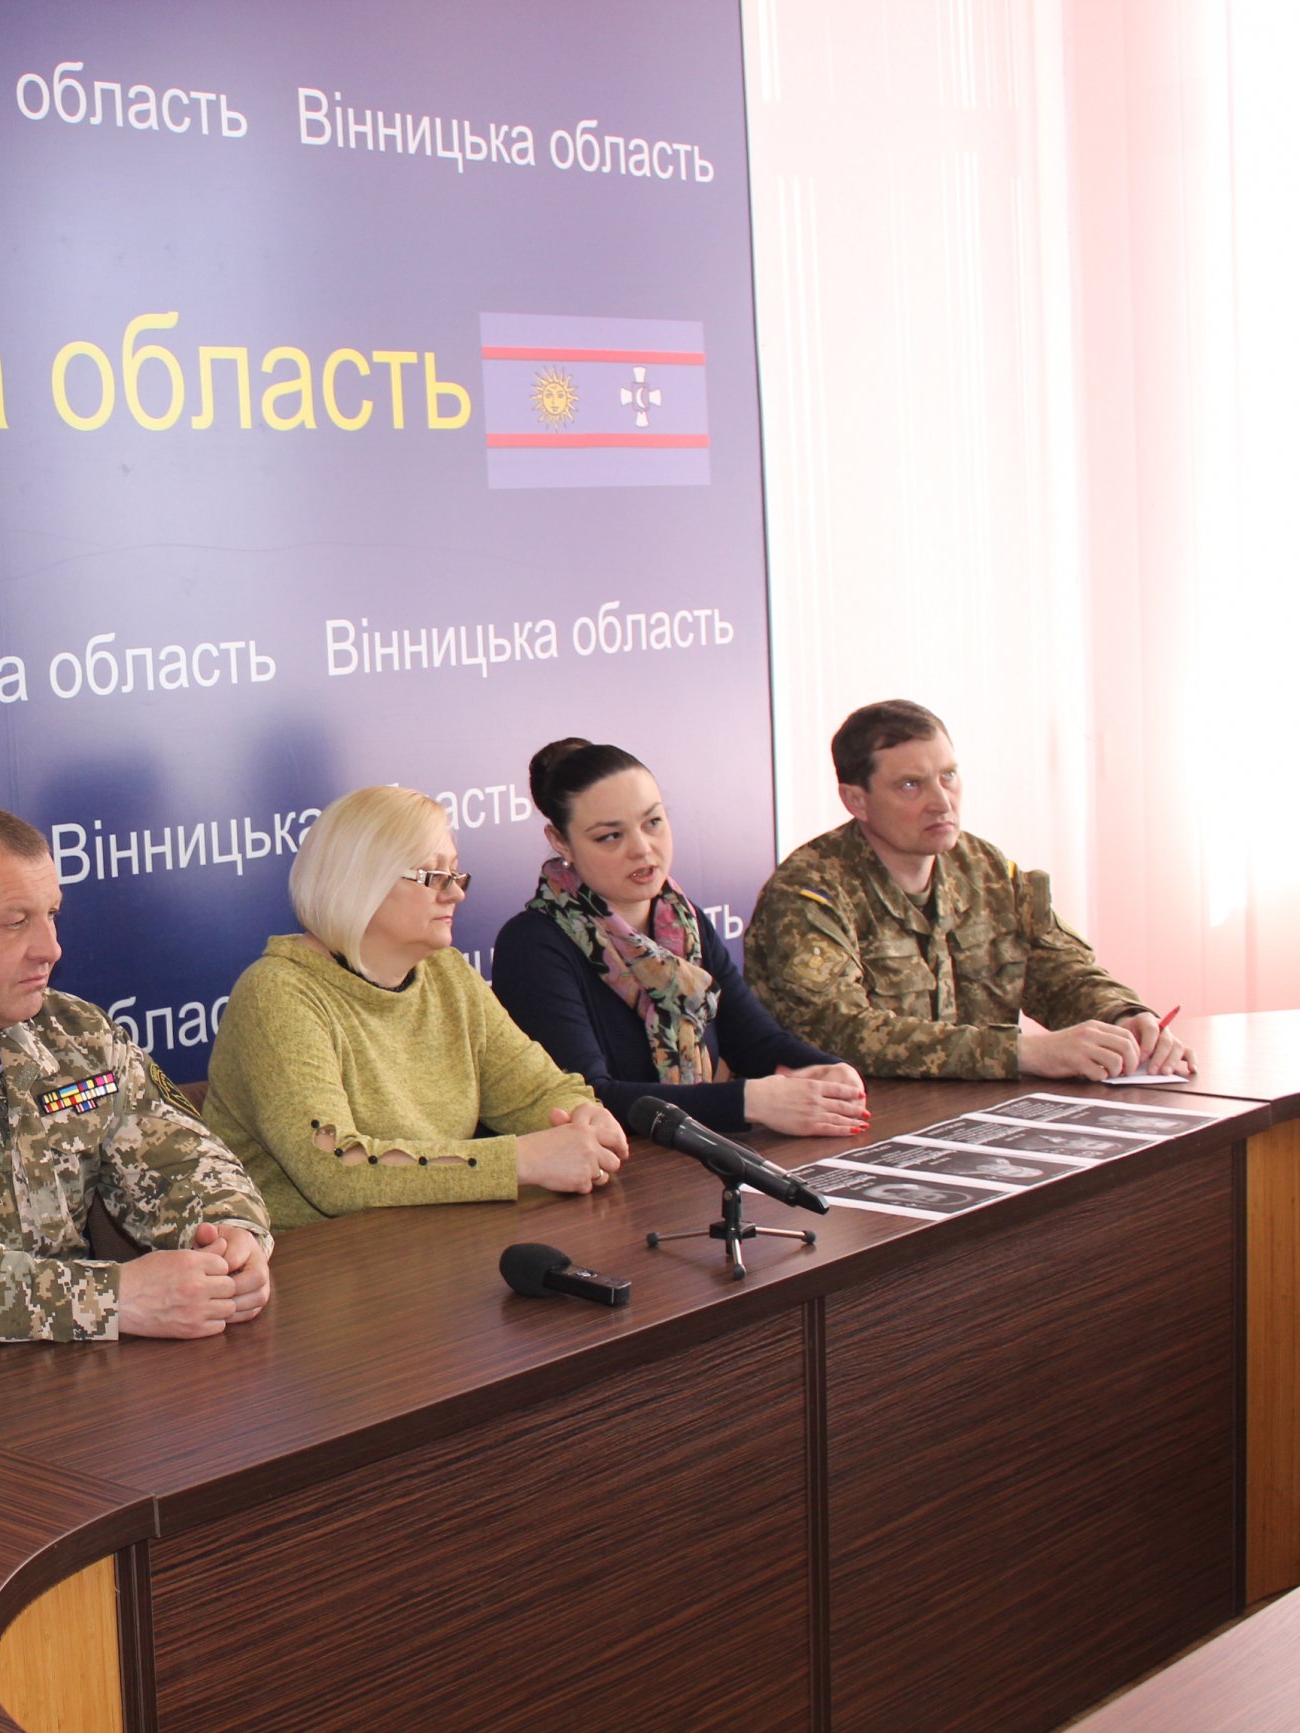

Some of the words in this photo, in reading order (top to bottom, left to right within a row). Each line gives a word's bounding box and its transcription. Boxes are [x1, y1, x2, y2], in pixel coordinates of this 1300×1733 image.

[16, 61, 248, 138] область
[298, 87, 536, 174] Вінницька
[549, 119, 715, 183] область
[51, 312, 472, 431] область
[49, 632, 277, 699] область
[325, 618, 559, 679] Вінницька
[572, 600, 735, 656] область
